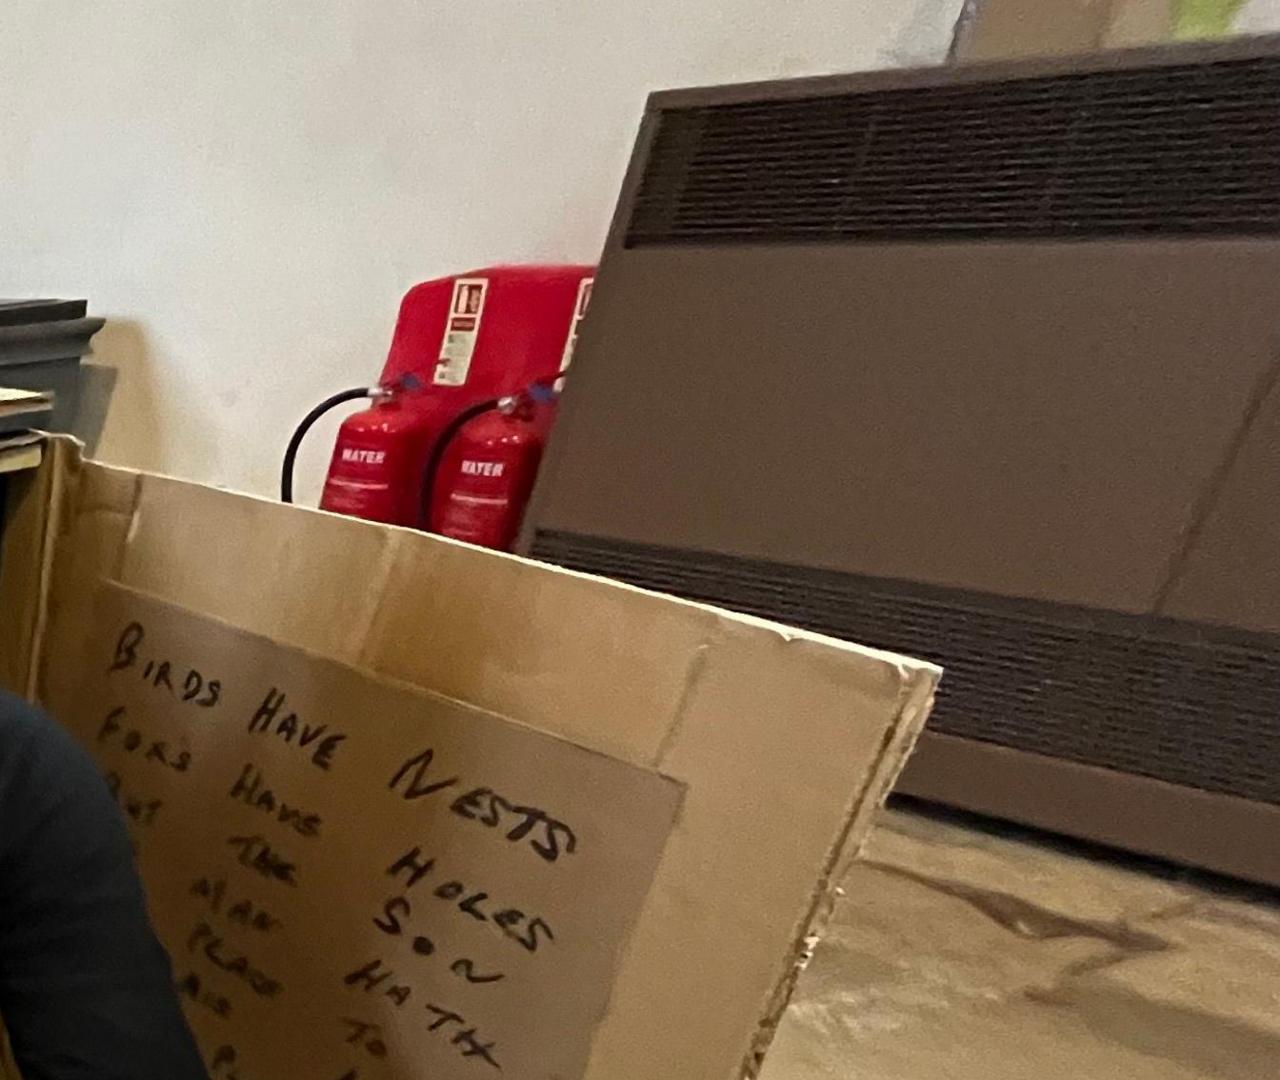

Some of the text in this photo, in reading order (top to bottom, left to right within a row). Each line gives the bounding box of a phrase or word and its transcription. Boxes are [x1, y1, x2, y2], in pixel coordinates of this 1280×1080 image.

[342, 449, 384, 464] WATER
[462, 461, 503, 477] WATER
[107, 621, 577, 862] BIRDS HAVE NESTS
[385, 847, 555, 953] HOLES
[344, 958, 502, 1071] HATH
